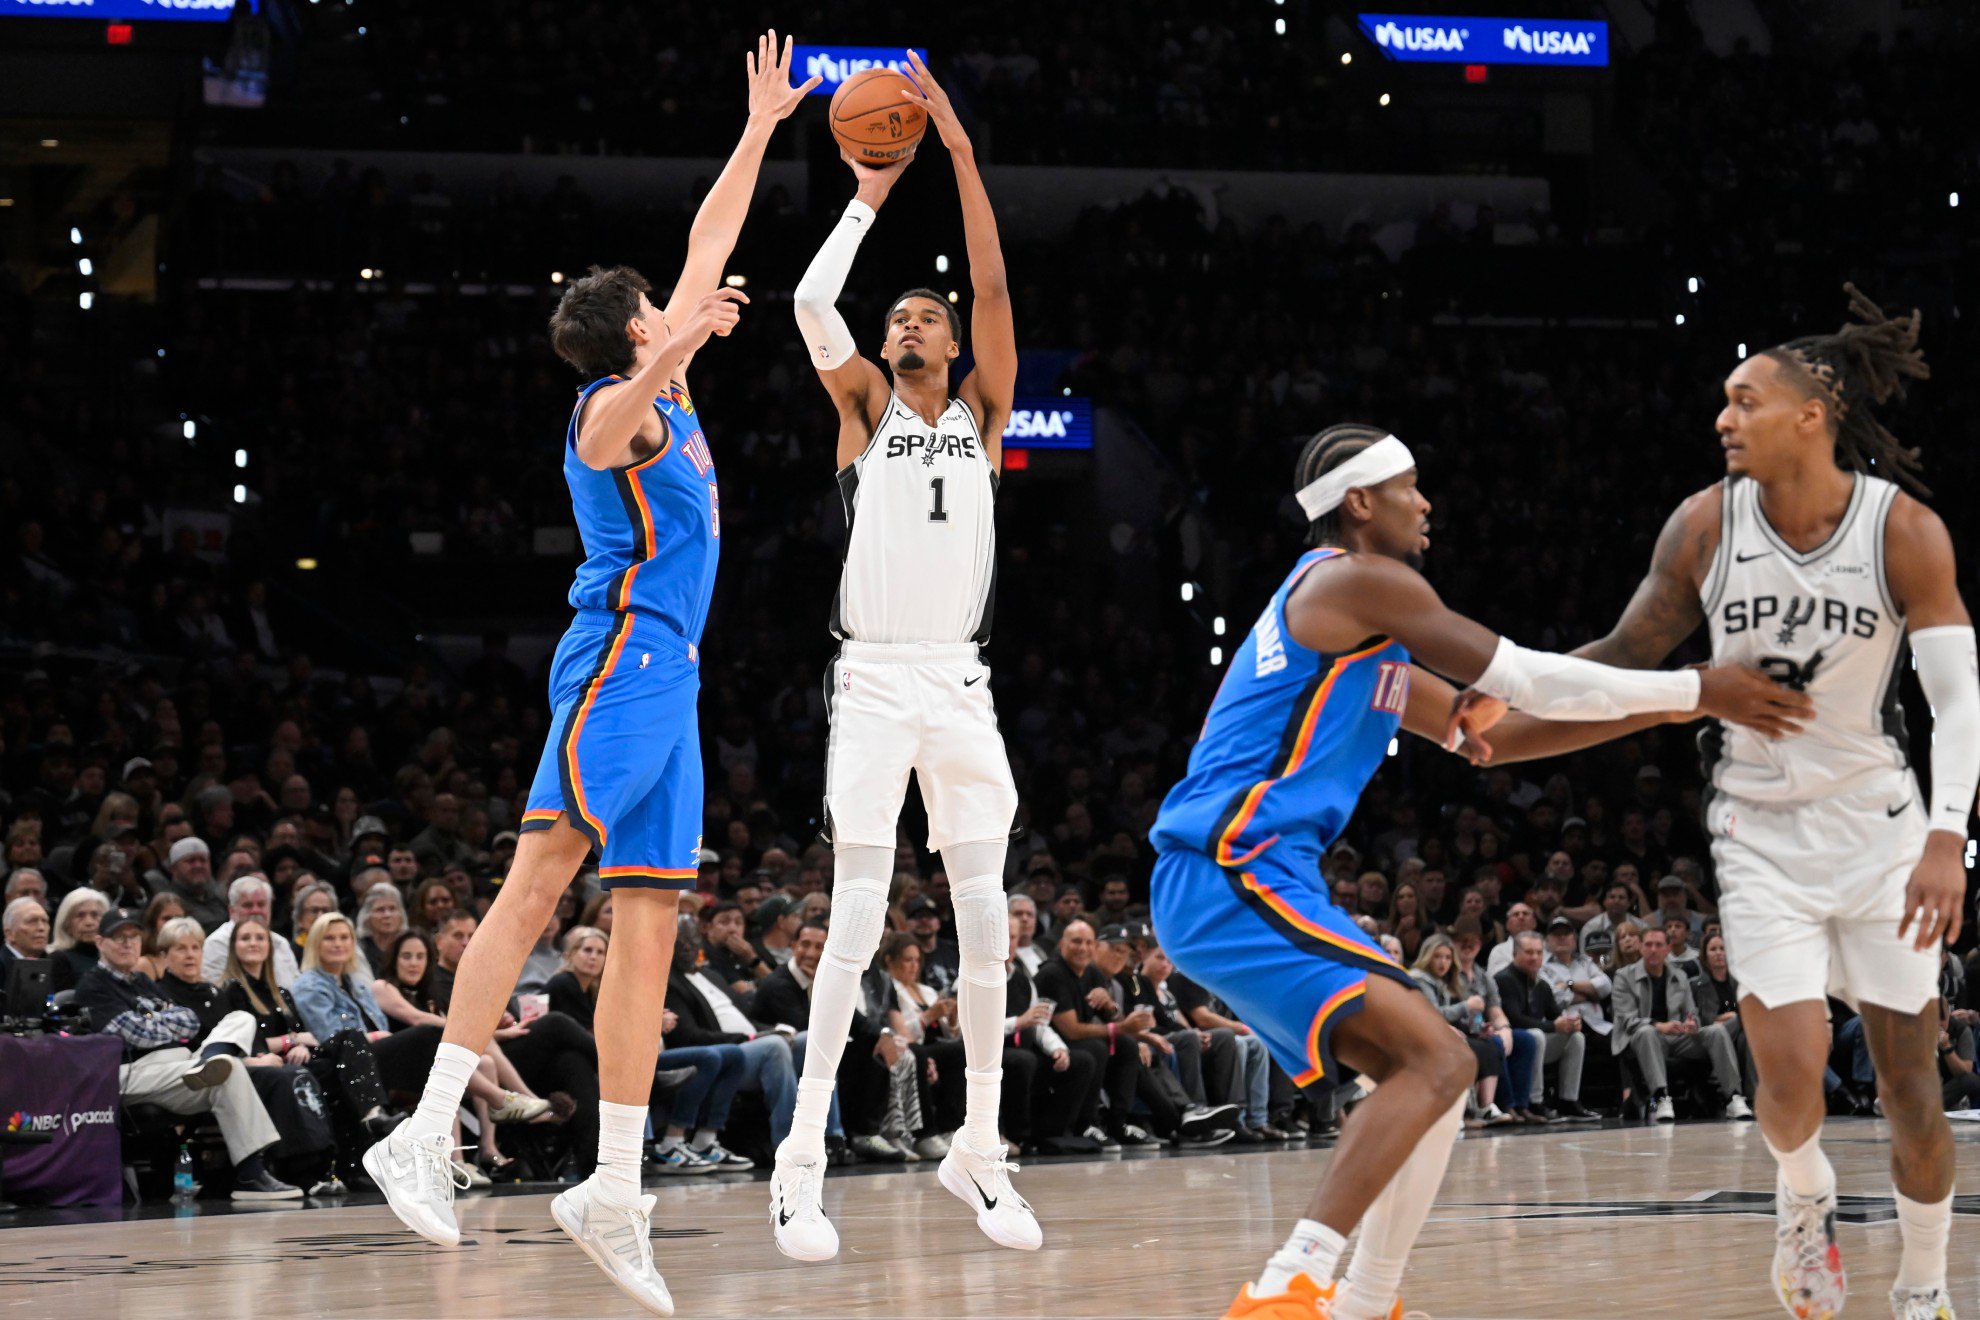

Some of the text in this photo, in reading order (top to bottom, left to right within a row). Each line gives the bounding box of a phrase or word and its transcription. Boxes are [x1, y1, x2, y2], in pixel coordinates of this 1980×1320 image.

[1405, 27, 1464, 51] USAA
[1532, 31, 1591, 55] USAA
[886, 432, 976, 467] SPURS
[928, 476, 949, 523] 1
[1724, 595, 1880, 646] SPURS
[32, 1113, 63, 1132] NBC
